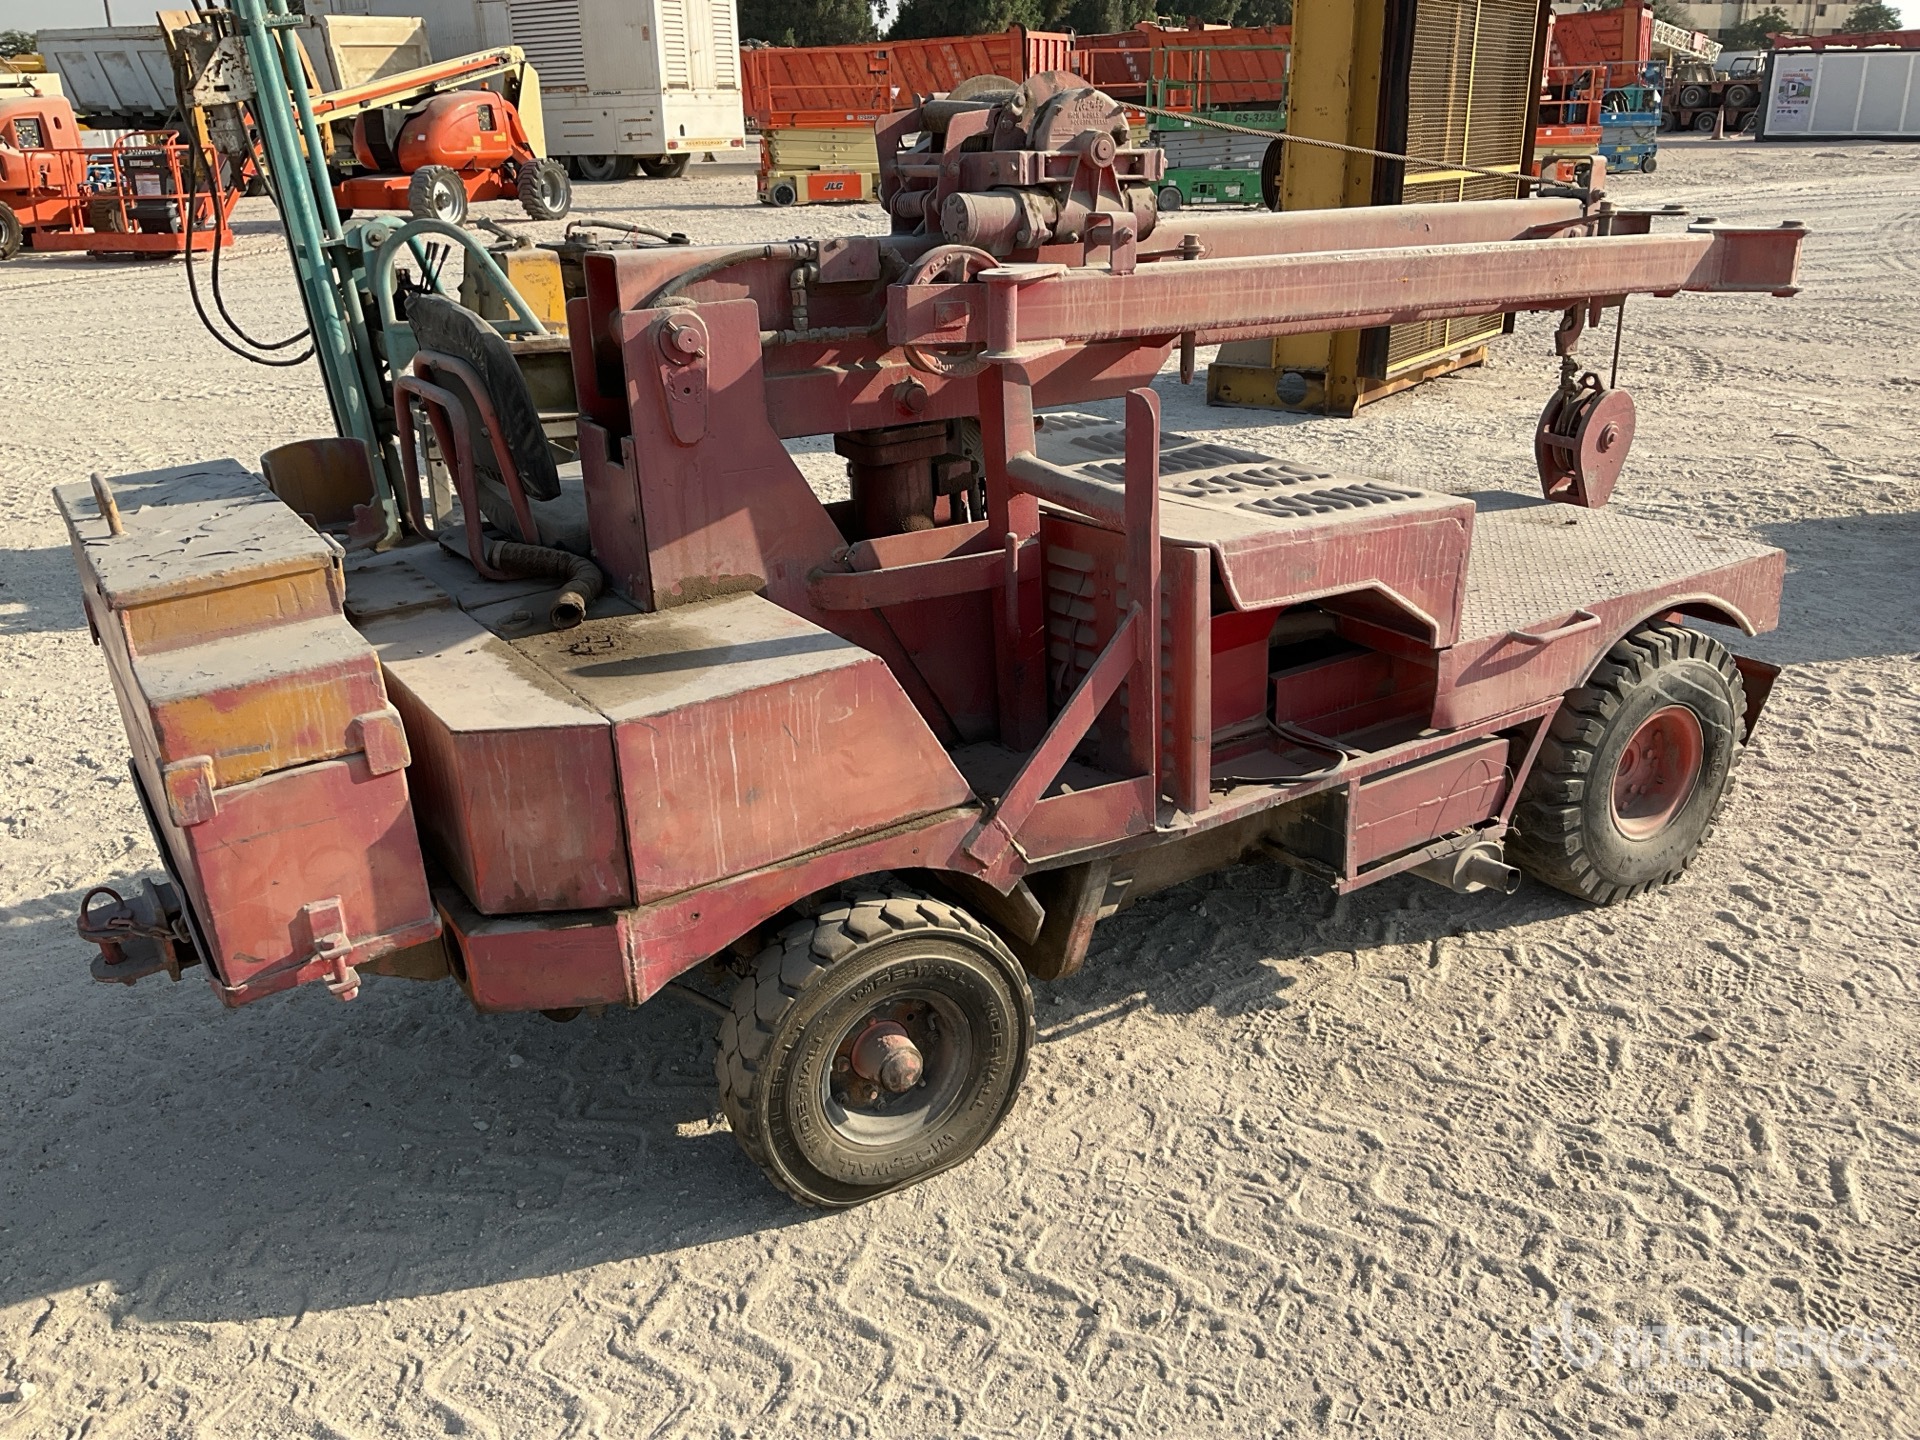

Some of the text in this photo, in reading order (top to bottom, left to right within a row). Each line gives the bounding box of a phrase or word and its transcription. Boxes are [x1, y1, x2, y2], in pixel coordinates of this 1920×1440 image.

[1234, 113, 1278, 123] GS-3232
[824, 181, 844, 191] JLG
[838, 1133, 957, 1176] WIDE-WALL
